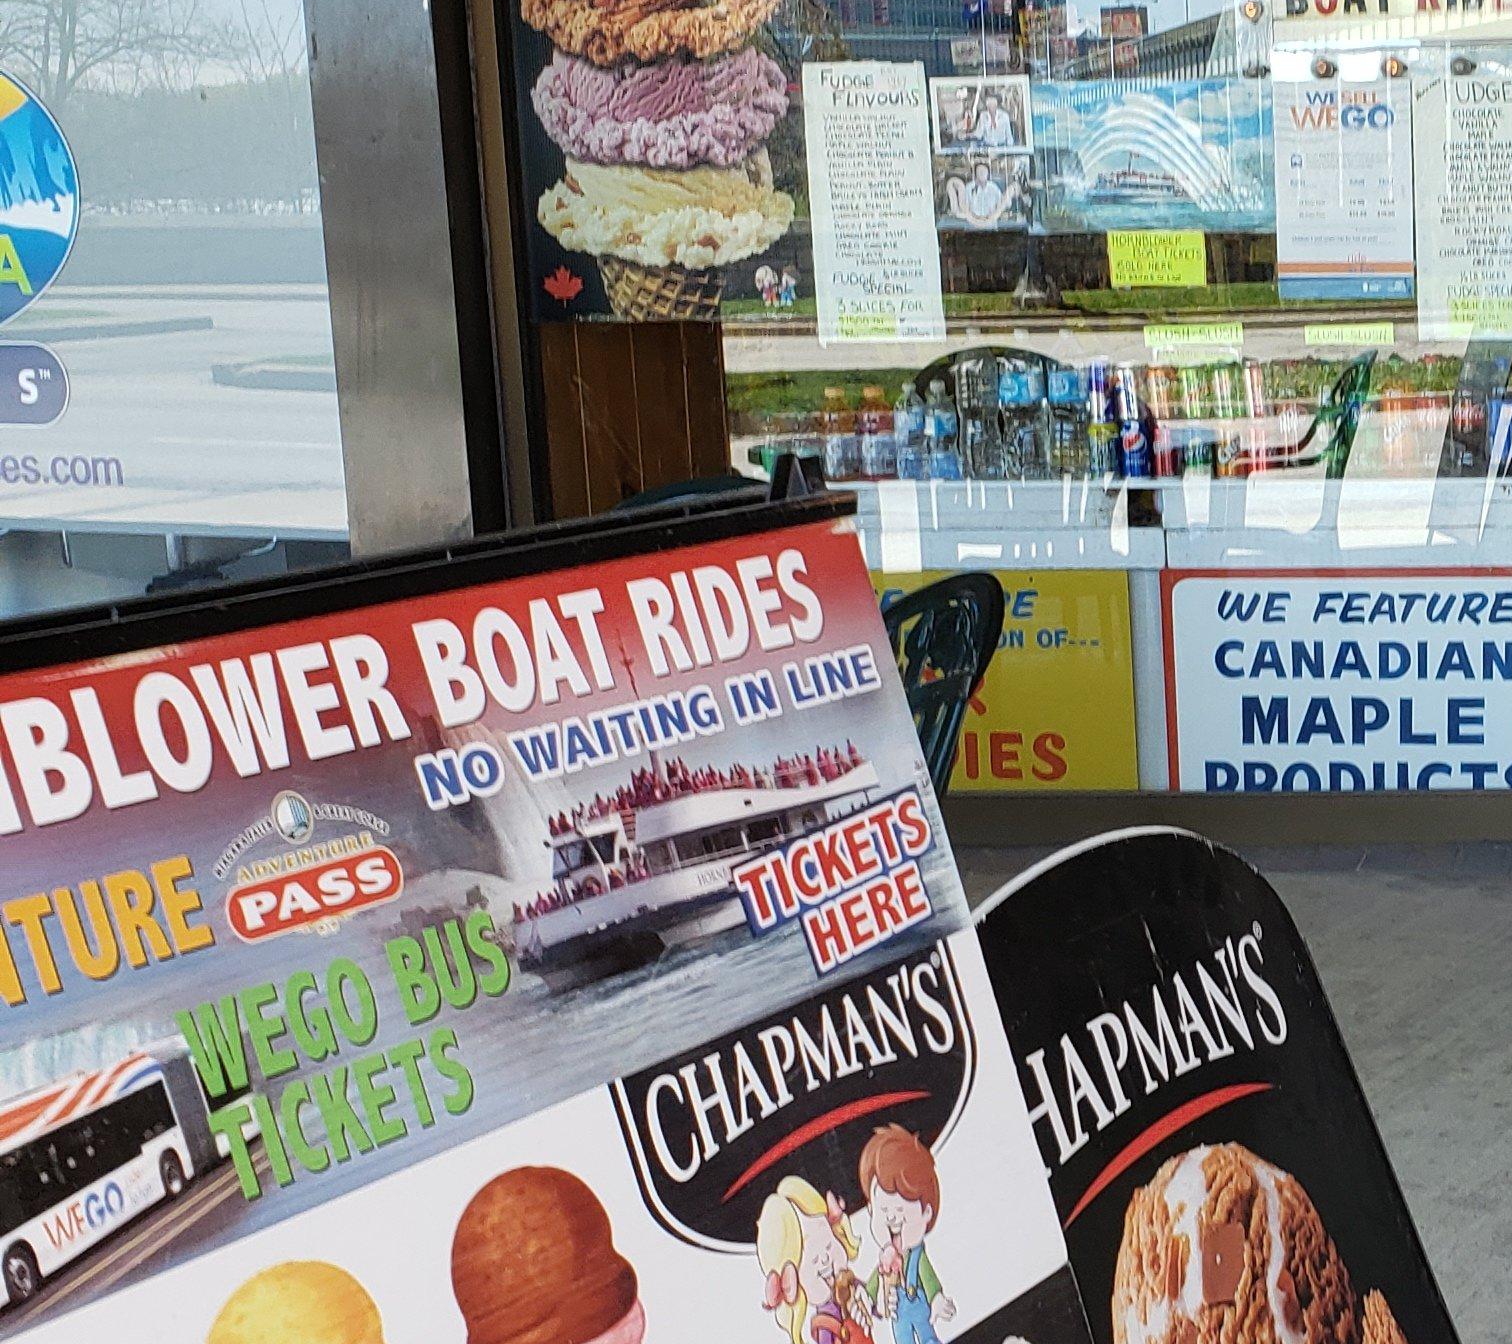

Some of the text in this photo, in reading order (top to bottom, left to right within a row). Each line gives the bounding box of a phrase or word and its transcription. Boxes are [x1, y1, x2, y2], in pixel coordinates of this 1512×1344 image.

[1290, 103, 1396, 132] WEGO
[1216, 589, 1291, 623] WE
[0, 547, 825, 836] BLOWER BOAT RIDES
[417, 646, 879, 807] NO WAITING IN LINE
[1241, 696, 1486, 746] MAPLE
[236, 856, 393, 931] PASS
[237, 830, 376, 886] ADVENTURE
[738, 799, 932, 924] TICKETS
[805, 869, 931, 973] HERE
[174, 909, 513, 1098] WEGO BUS
[1026, 933, 1288, 1166] HAPMAN'S
[208, 1027, 475, 1201] TICKETS
[646, 959, 956, 1182] CHAPMAN'S
[42, 1180, 124, 1251] WEGO
